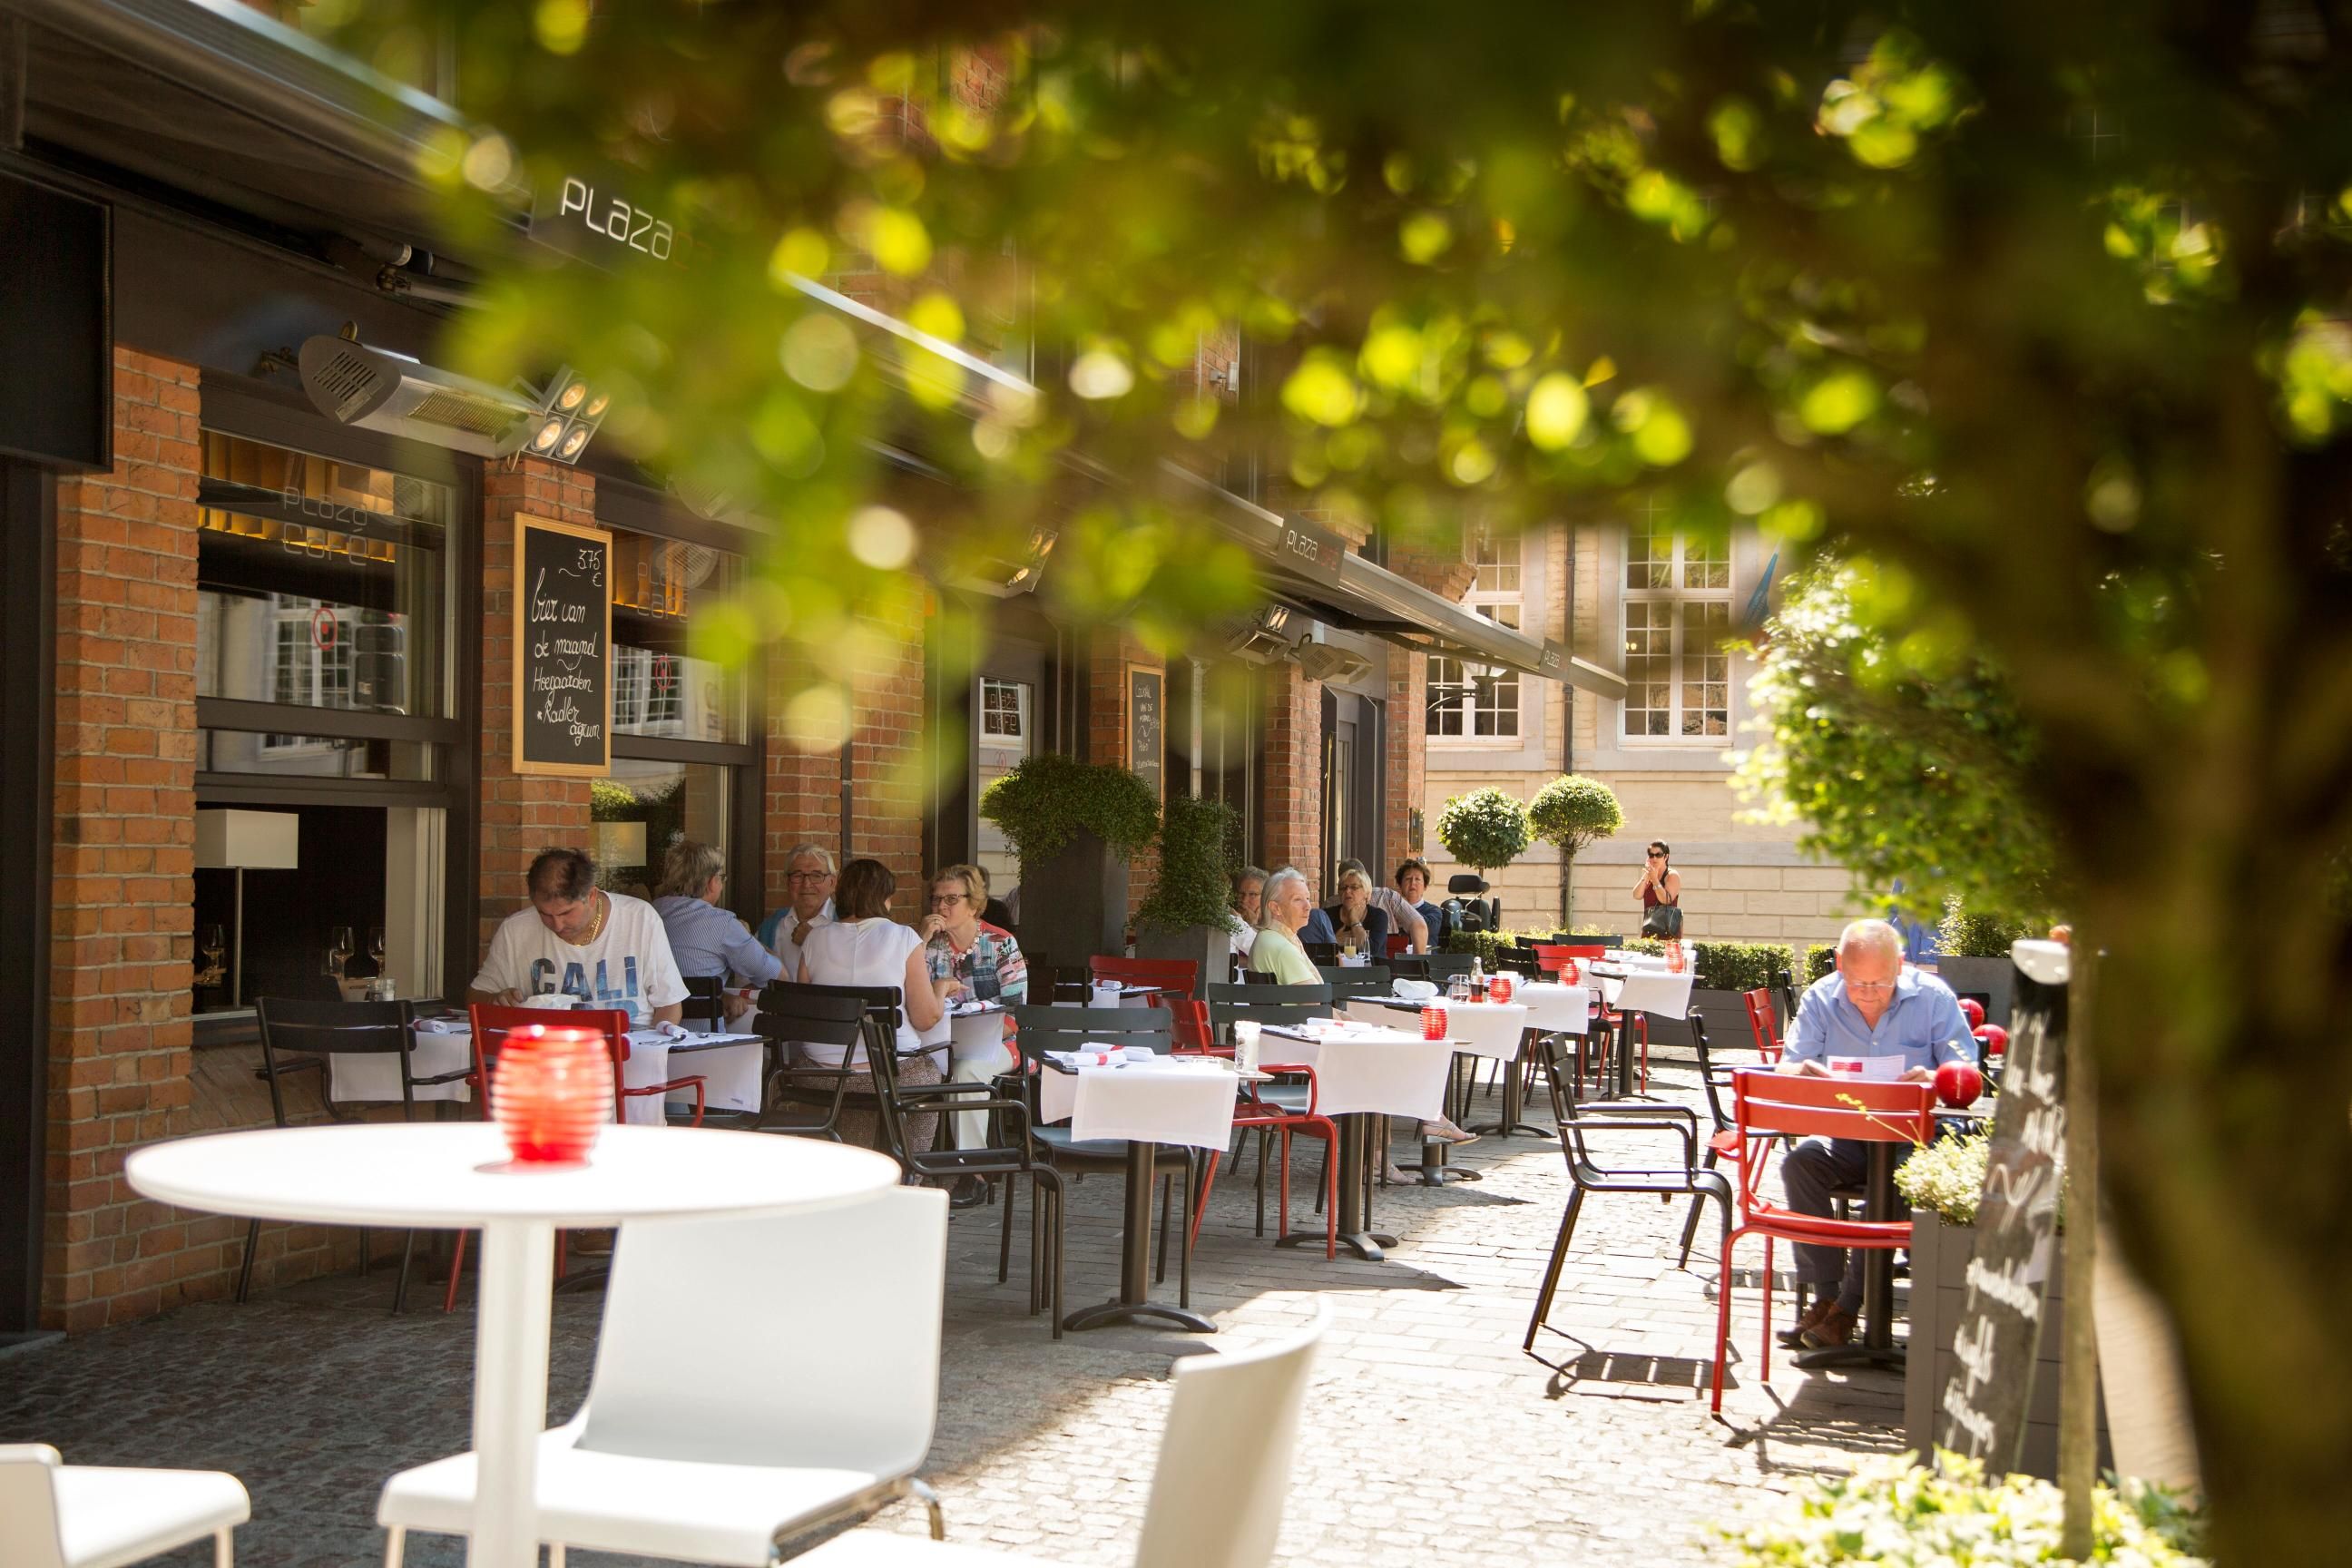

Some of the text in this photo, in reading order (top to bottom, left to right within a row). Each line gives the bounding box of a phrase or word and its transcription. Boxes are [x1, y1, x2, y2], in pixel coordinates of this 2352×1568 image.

[577, 548, 603, 570] 375
[593, 569, 603, 587] €
[562, 602, 586, 624] van
[534, 630, 600, 659] de maand
[533, 666, 594, 701] Hoegaarden
[531, 956, 639, 1002] CALI
